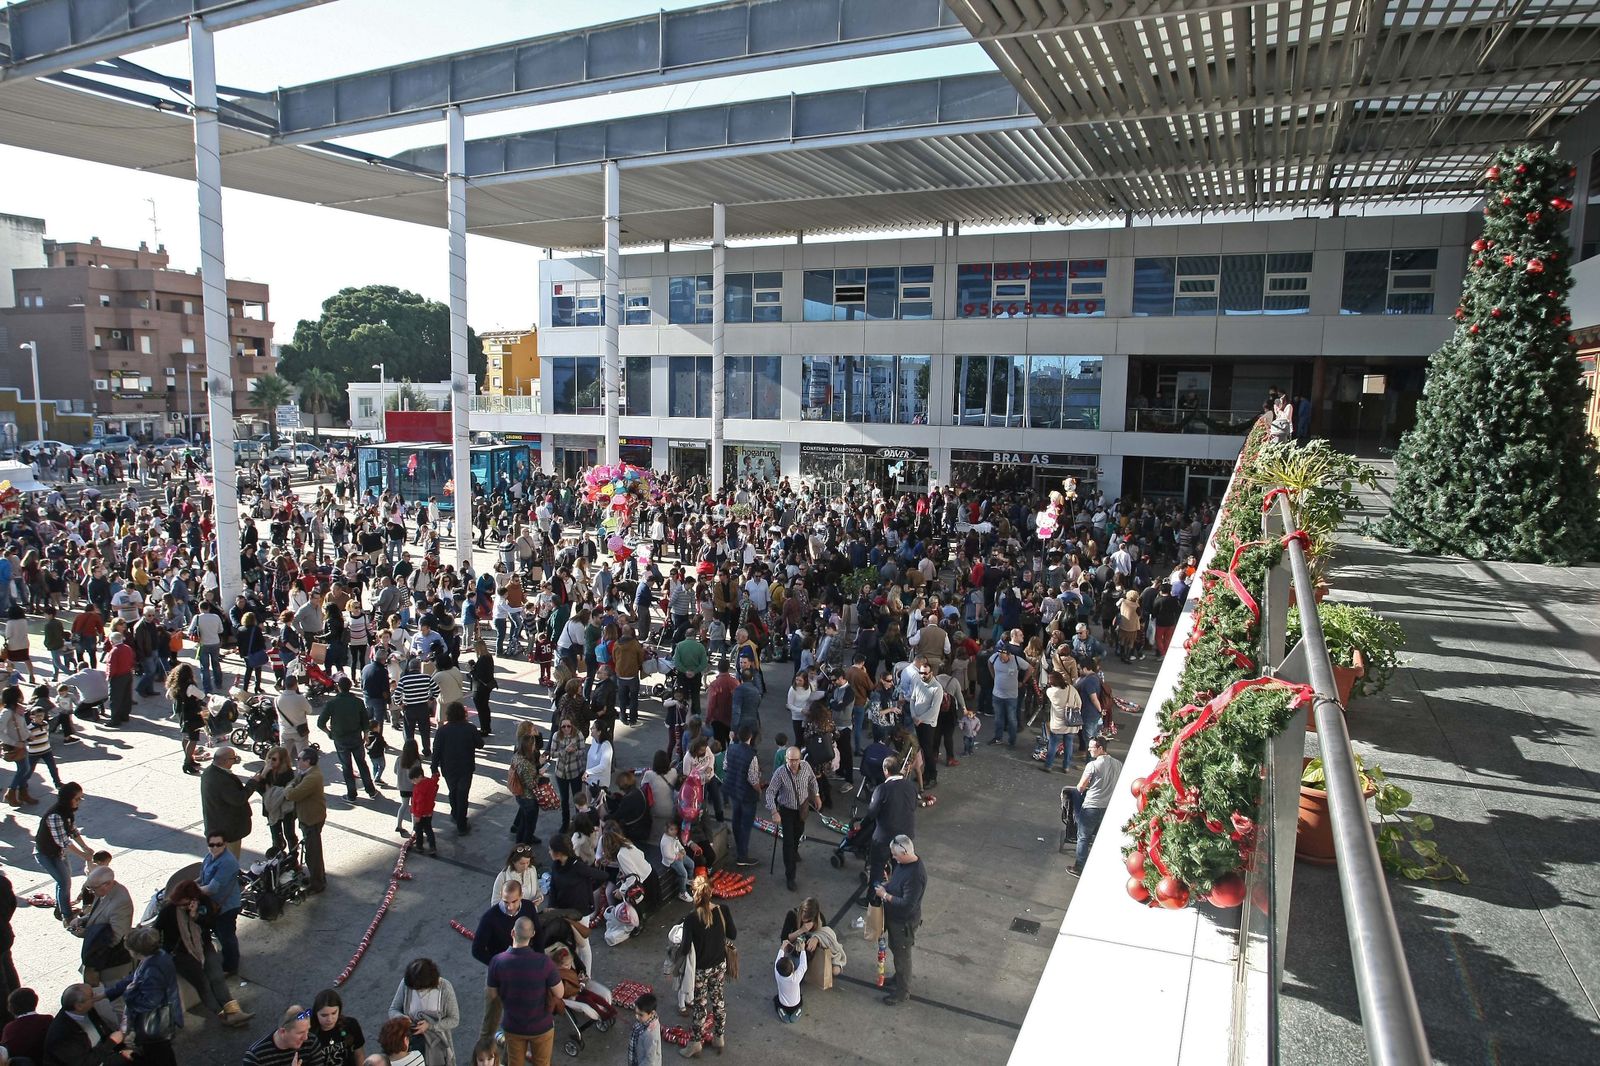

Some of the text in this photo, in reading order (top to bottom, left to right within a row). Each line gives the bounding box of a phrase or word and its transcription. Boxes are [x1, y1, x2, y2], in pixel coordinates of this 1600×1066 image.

[963, 301, 1097, 316] 956654649
[741, 446, 776, 459] hogarium
[884, 449, 910, 459] DAVER
[541, 644, 551, 654] 36
